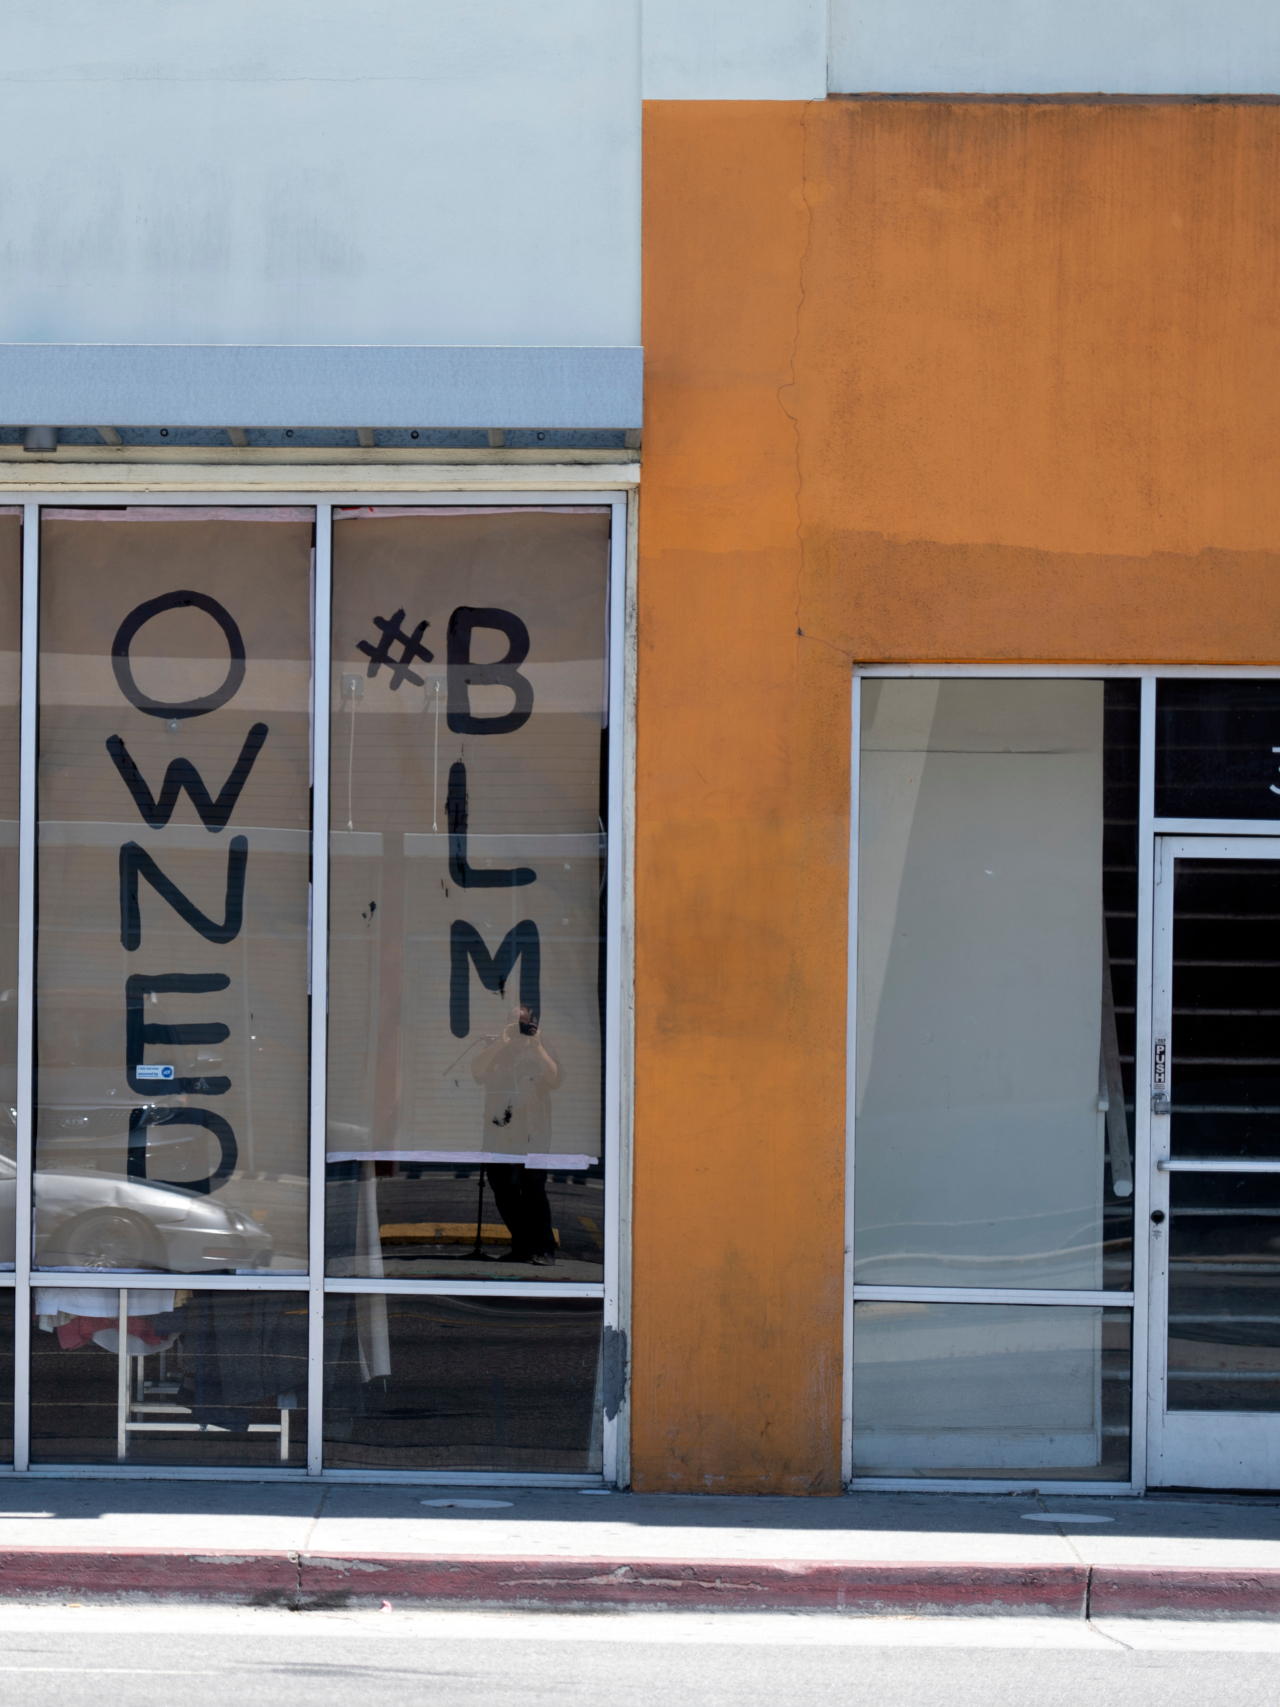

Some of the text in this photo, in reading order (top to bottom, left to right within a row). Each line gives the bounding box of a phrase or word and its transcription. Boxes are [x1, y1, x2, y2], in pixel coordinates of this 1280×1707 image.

[106, 590, 269, 1198] OWNED
[356, 606, 540, 1038] #BLM
[1155, 1045, 1165, 1083] PUSH
